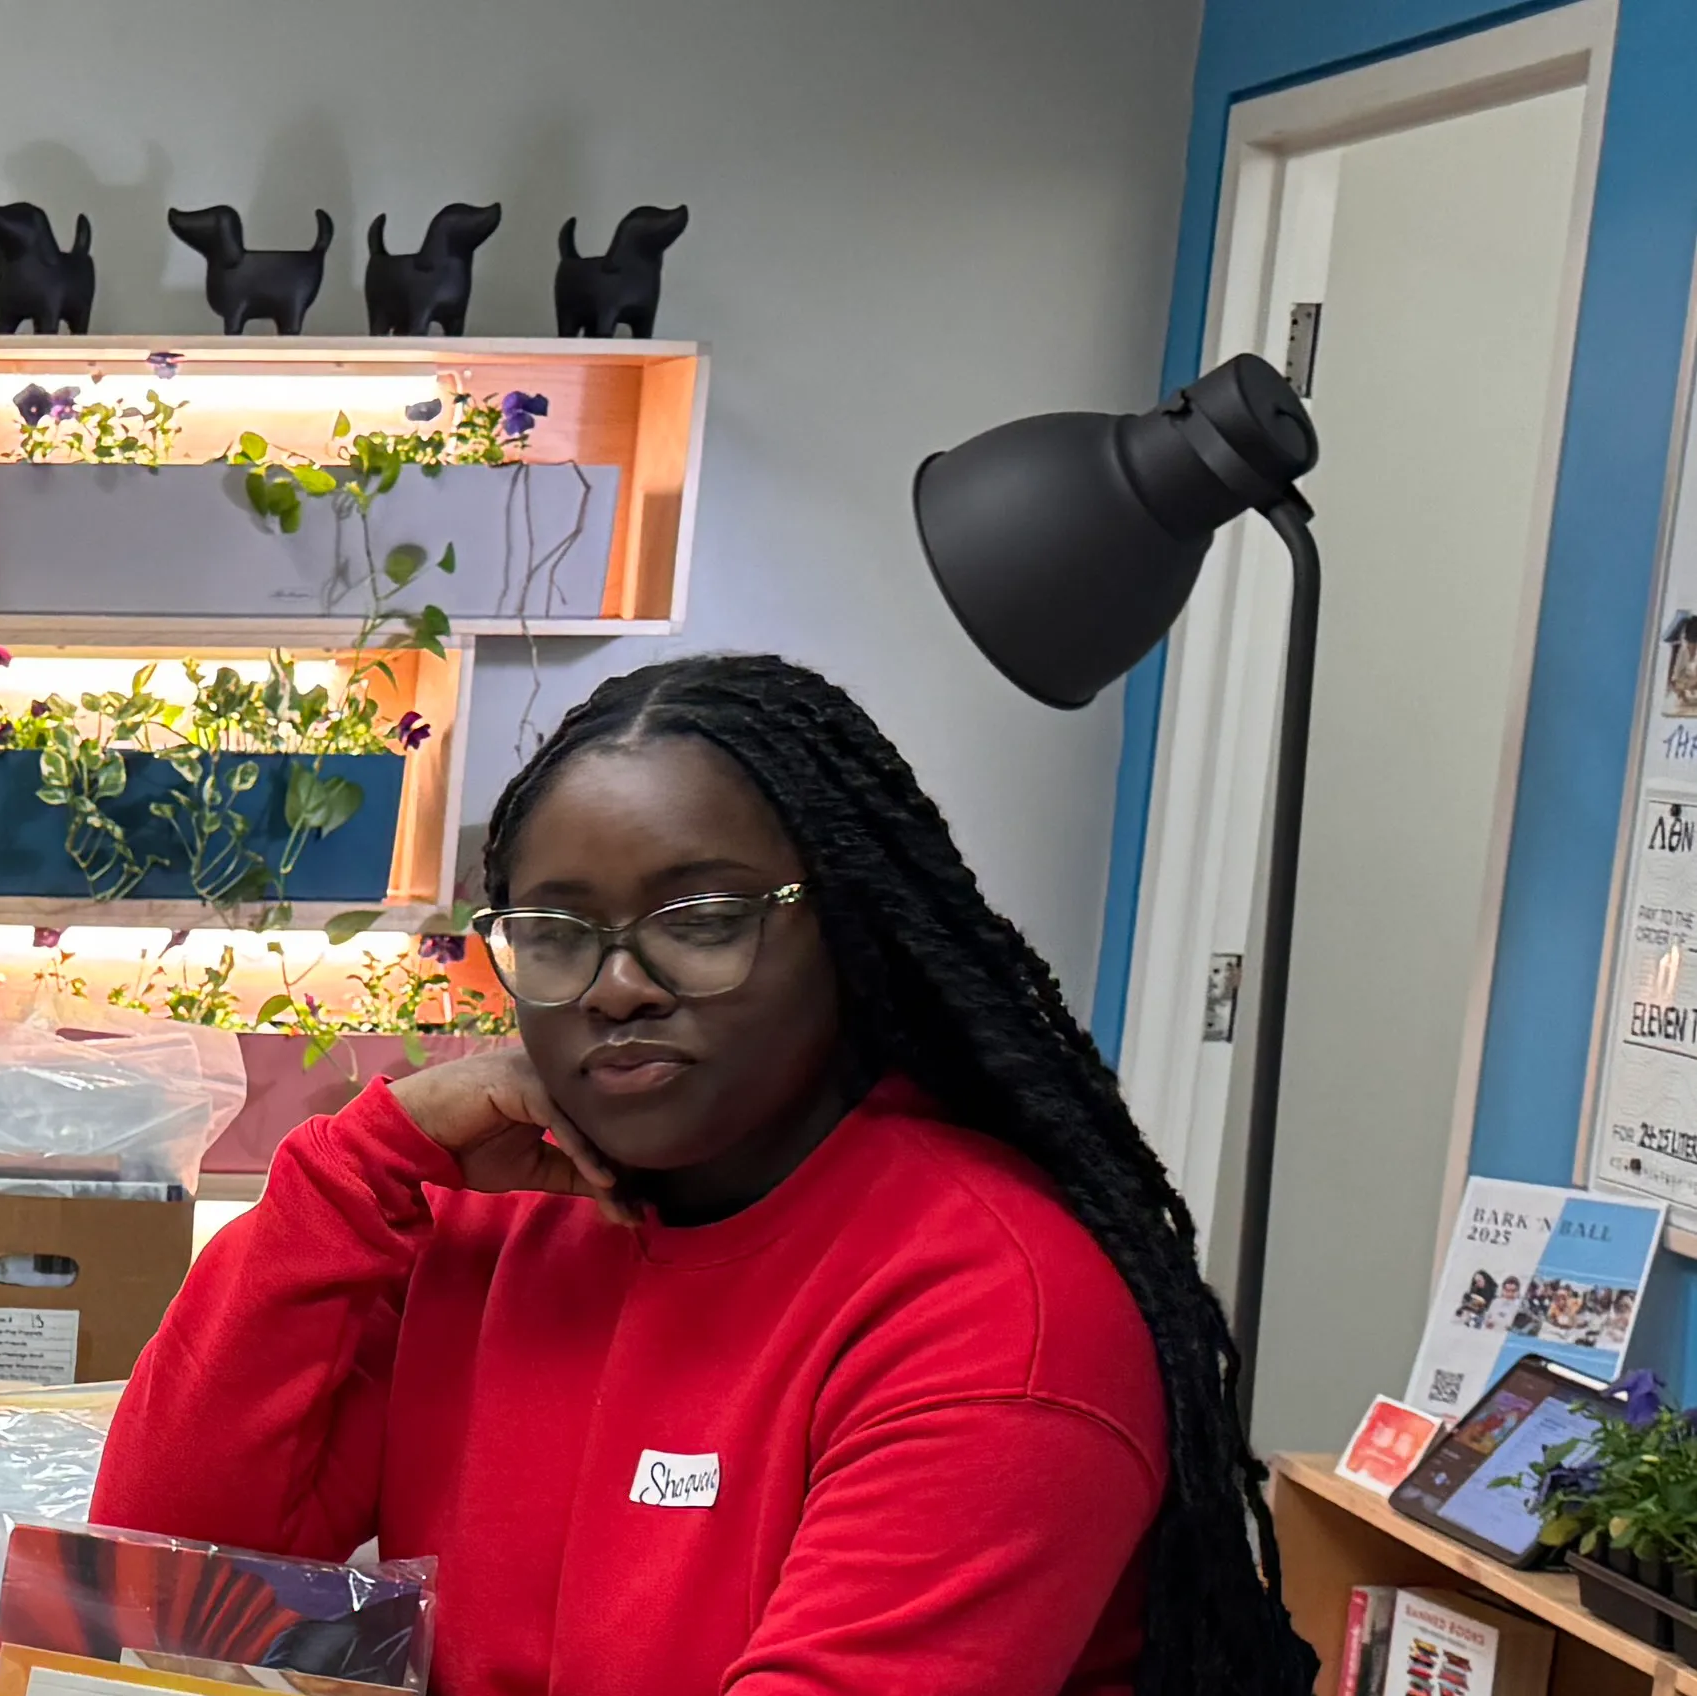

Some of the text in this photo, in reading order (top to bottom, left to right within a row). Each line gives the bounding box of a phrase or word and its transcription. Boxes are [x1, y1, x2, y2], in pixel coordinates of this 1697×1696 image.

[1631, 1002, 1688, 1042] ELEVEN
[1467, 1226, 1512, 1245] 2025
[1473, 1207, 1527, 1229] BARK
[1560, 1219, 1613, 1241] BALL
